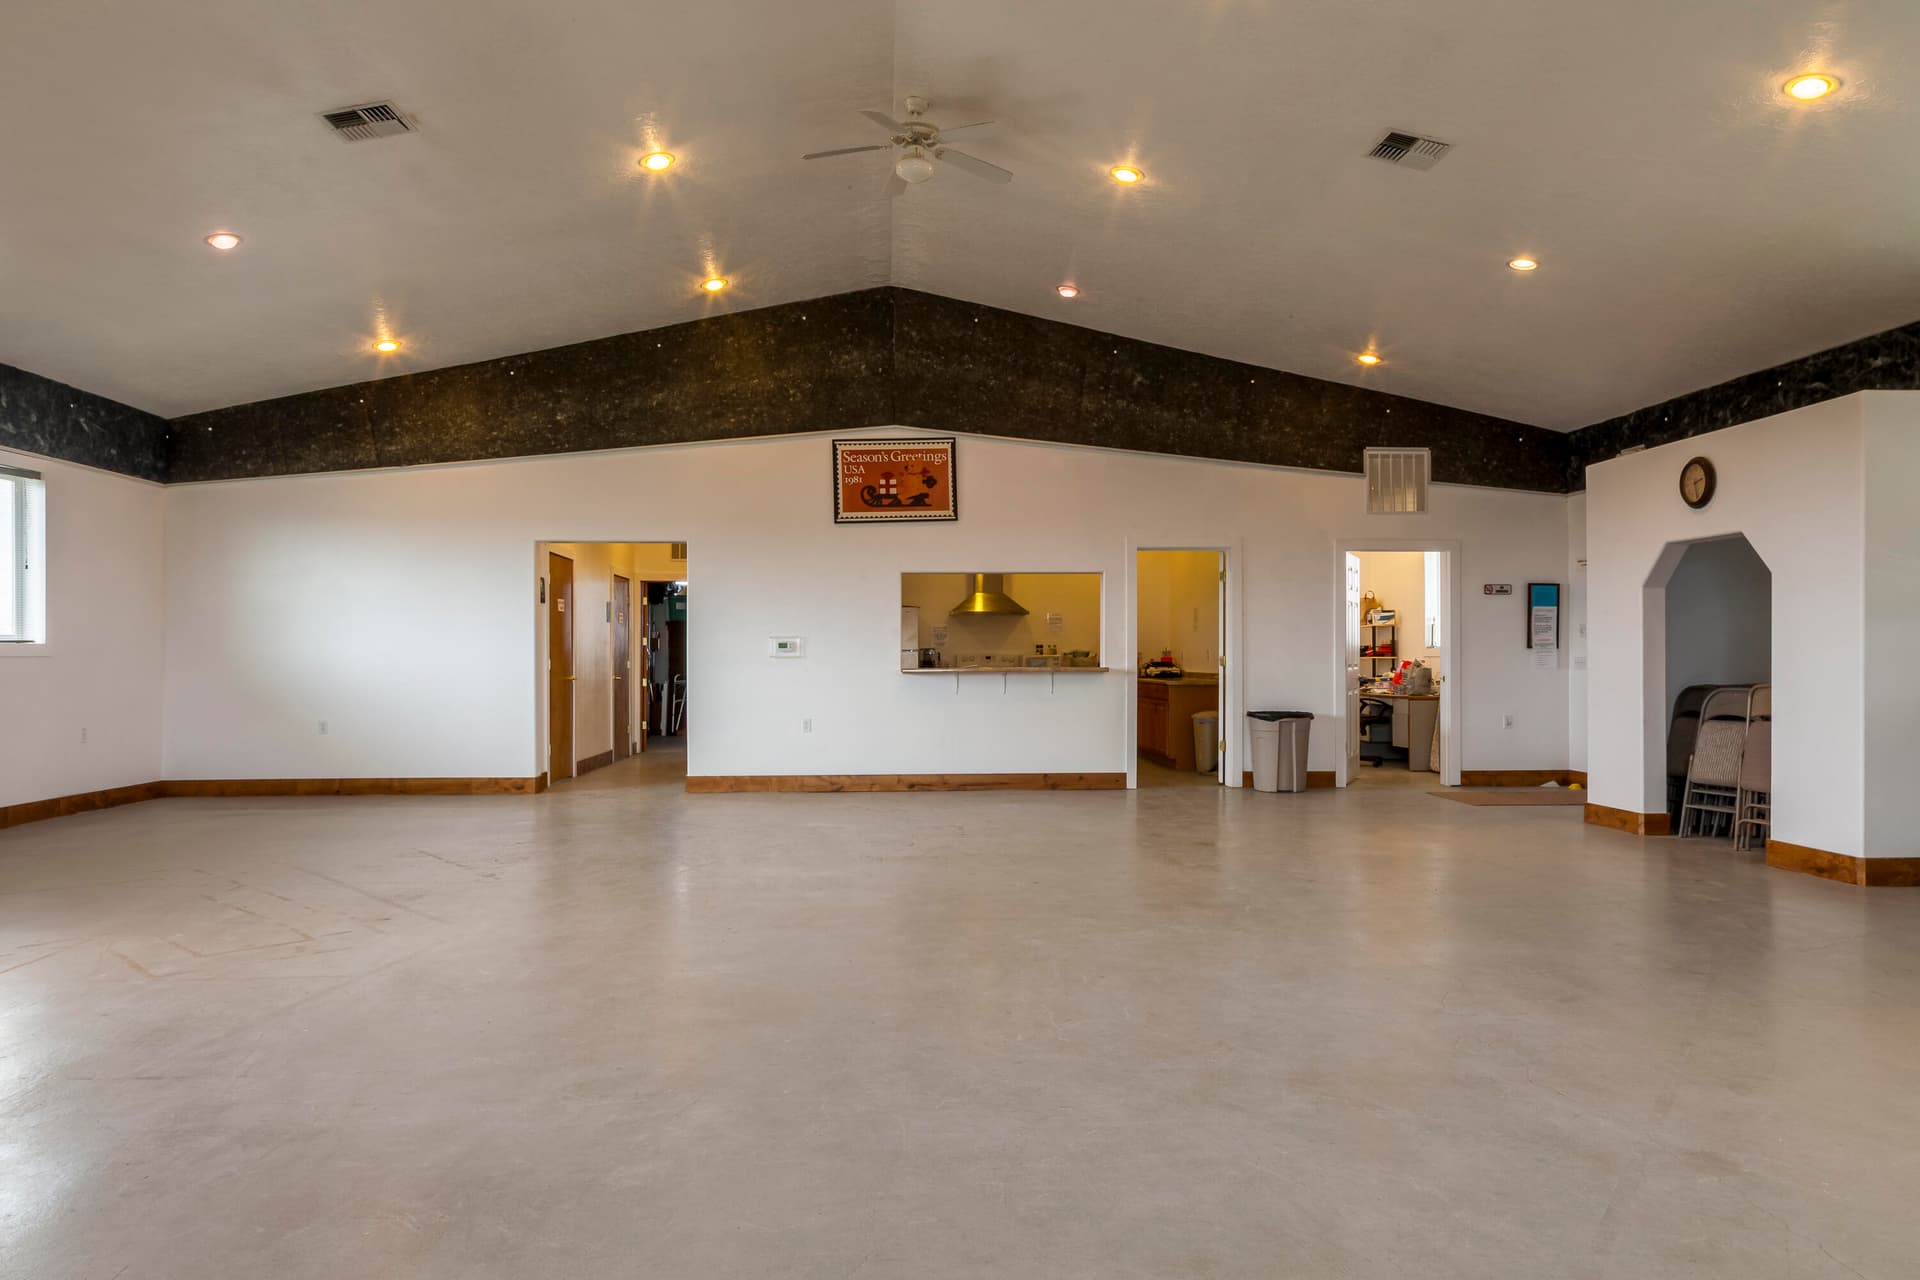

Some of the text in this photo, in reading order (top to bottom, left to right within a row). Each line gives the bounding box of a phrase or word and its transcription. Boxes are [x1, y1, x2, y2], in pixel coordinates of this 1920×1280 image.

[843, 450, 947, 465] Season's Greetings
[844, 465, 866, 474] USA
[844, 476, 863, 485] 1981
